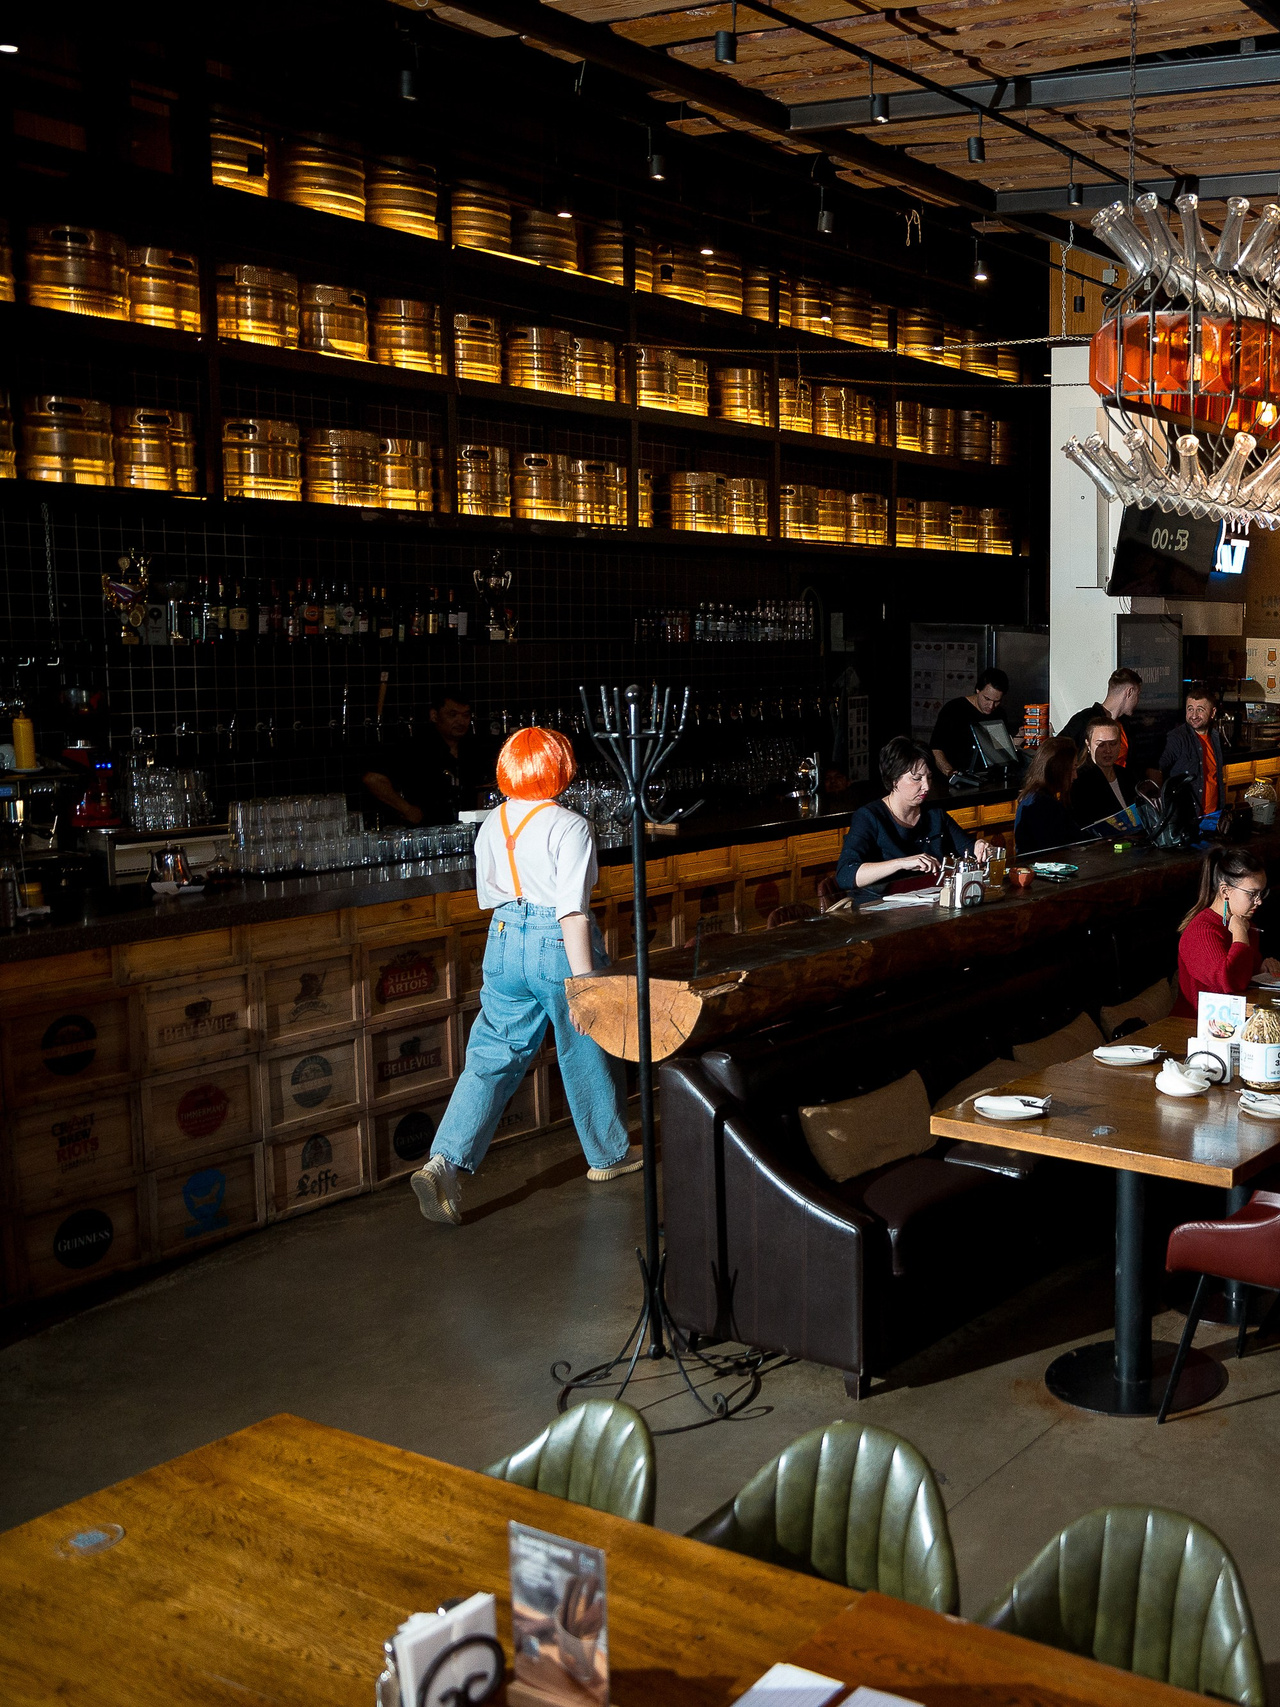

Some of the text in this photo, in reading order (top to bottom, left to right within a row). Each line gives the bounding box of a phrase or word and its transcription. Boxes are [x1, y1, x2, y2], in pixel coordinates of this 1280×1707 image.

[1151, 527, 1190, 551] 00:53
[387, 968, 428, 984] STELLA
[387, 979, 428, 995] ARTOIS
[180, 1104, 226, 1121] TIMMERMANS
[500, 1113, 524, 1128] TEN
[51, 1113, 96, 1137] CRAFT
[59, 1128, 91, 1148] BREW
[56, 1136, 99, 1164] RIOTS
[295, 1168, 339, 1199] Leffe
[57, 1228, 111, 1253] GUINNESS
